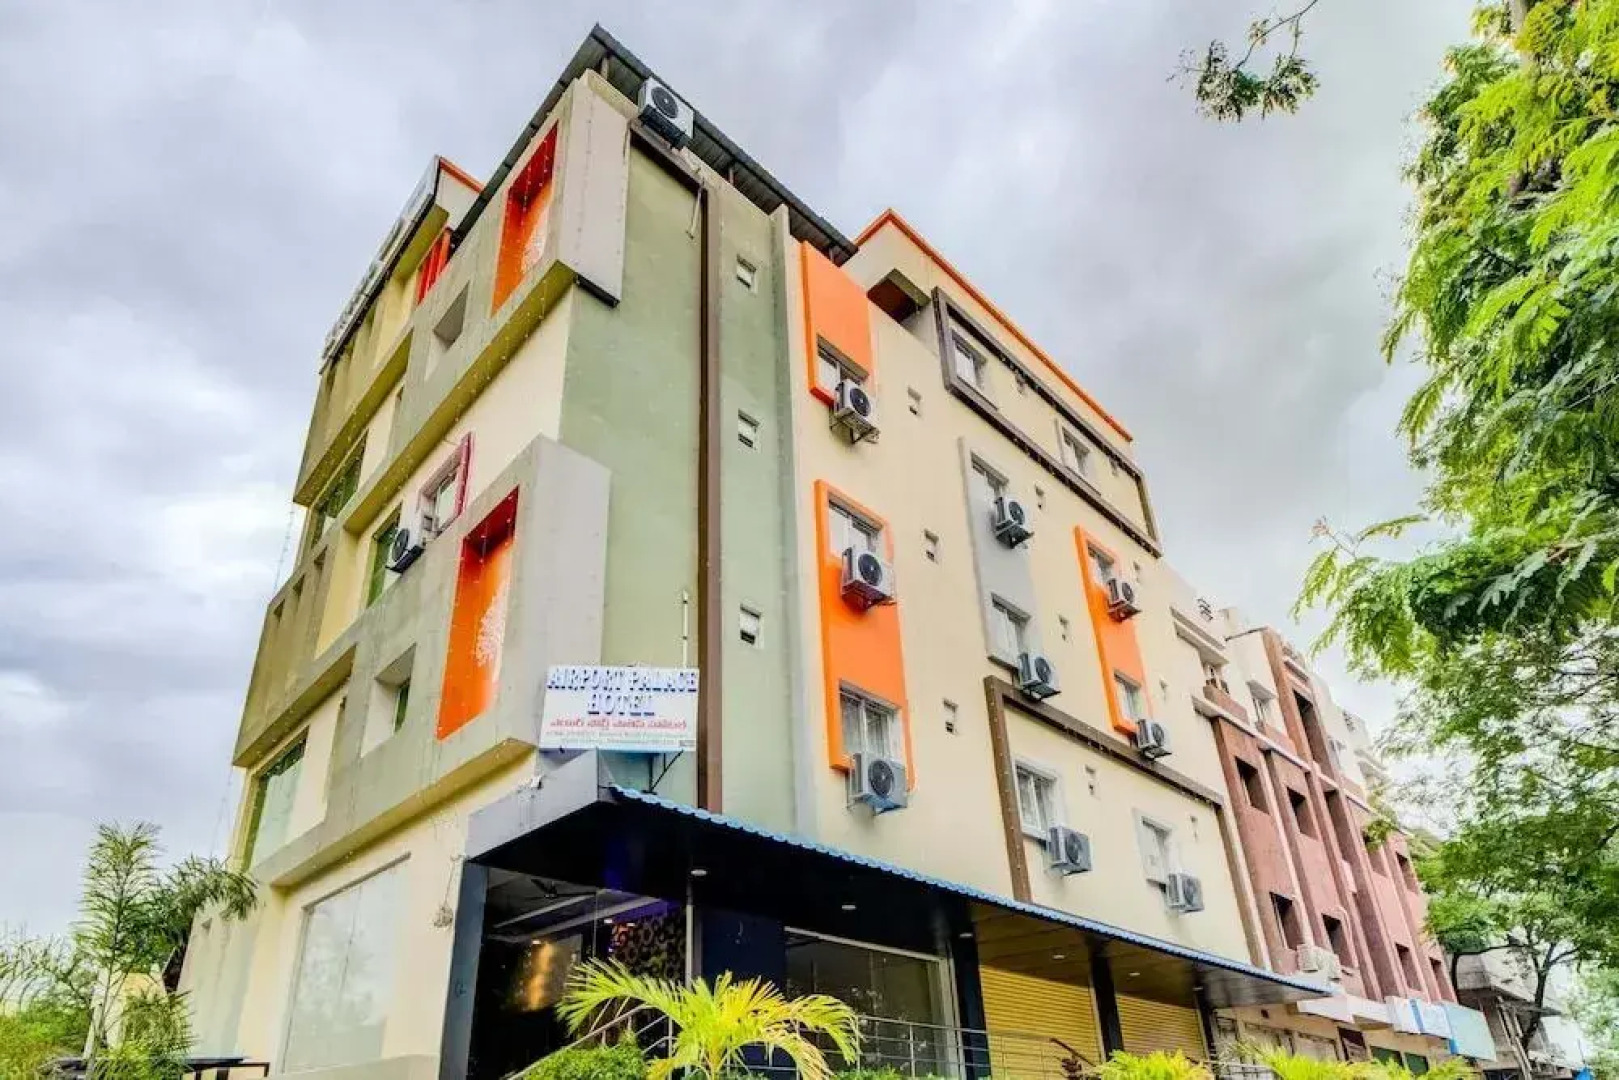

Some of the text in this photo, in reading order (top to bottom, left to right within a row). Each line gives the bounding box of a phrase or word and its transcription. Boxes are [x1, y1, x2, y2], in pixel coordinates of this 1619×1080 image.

[547, 669, 697, 693] AIRPORT PALACE
[587, 693, 655, 717] HOTEL
